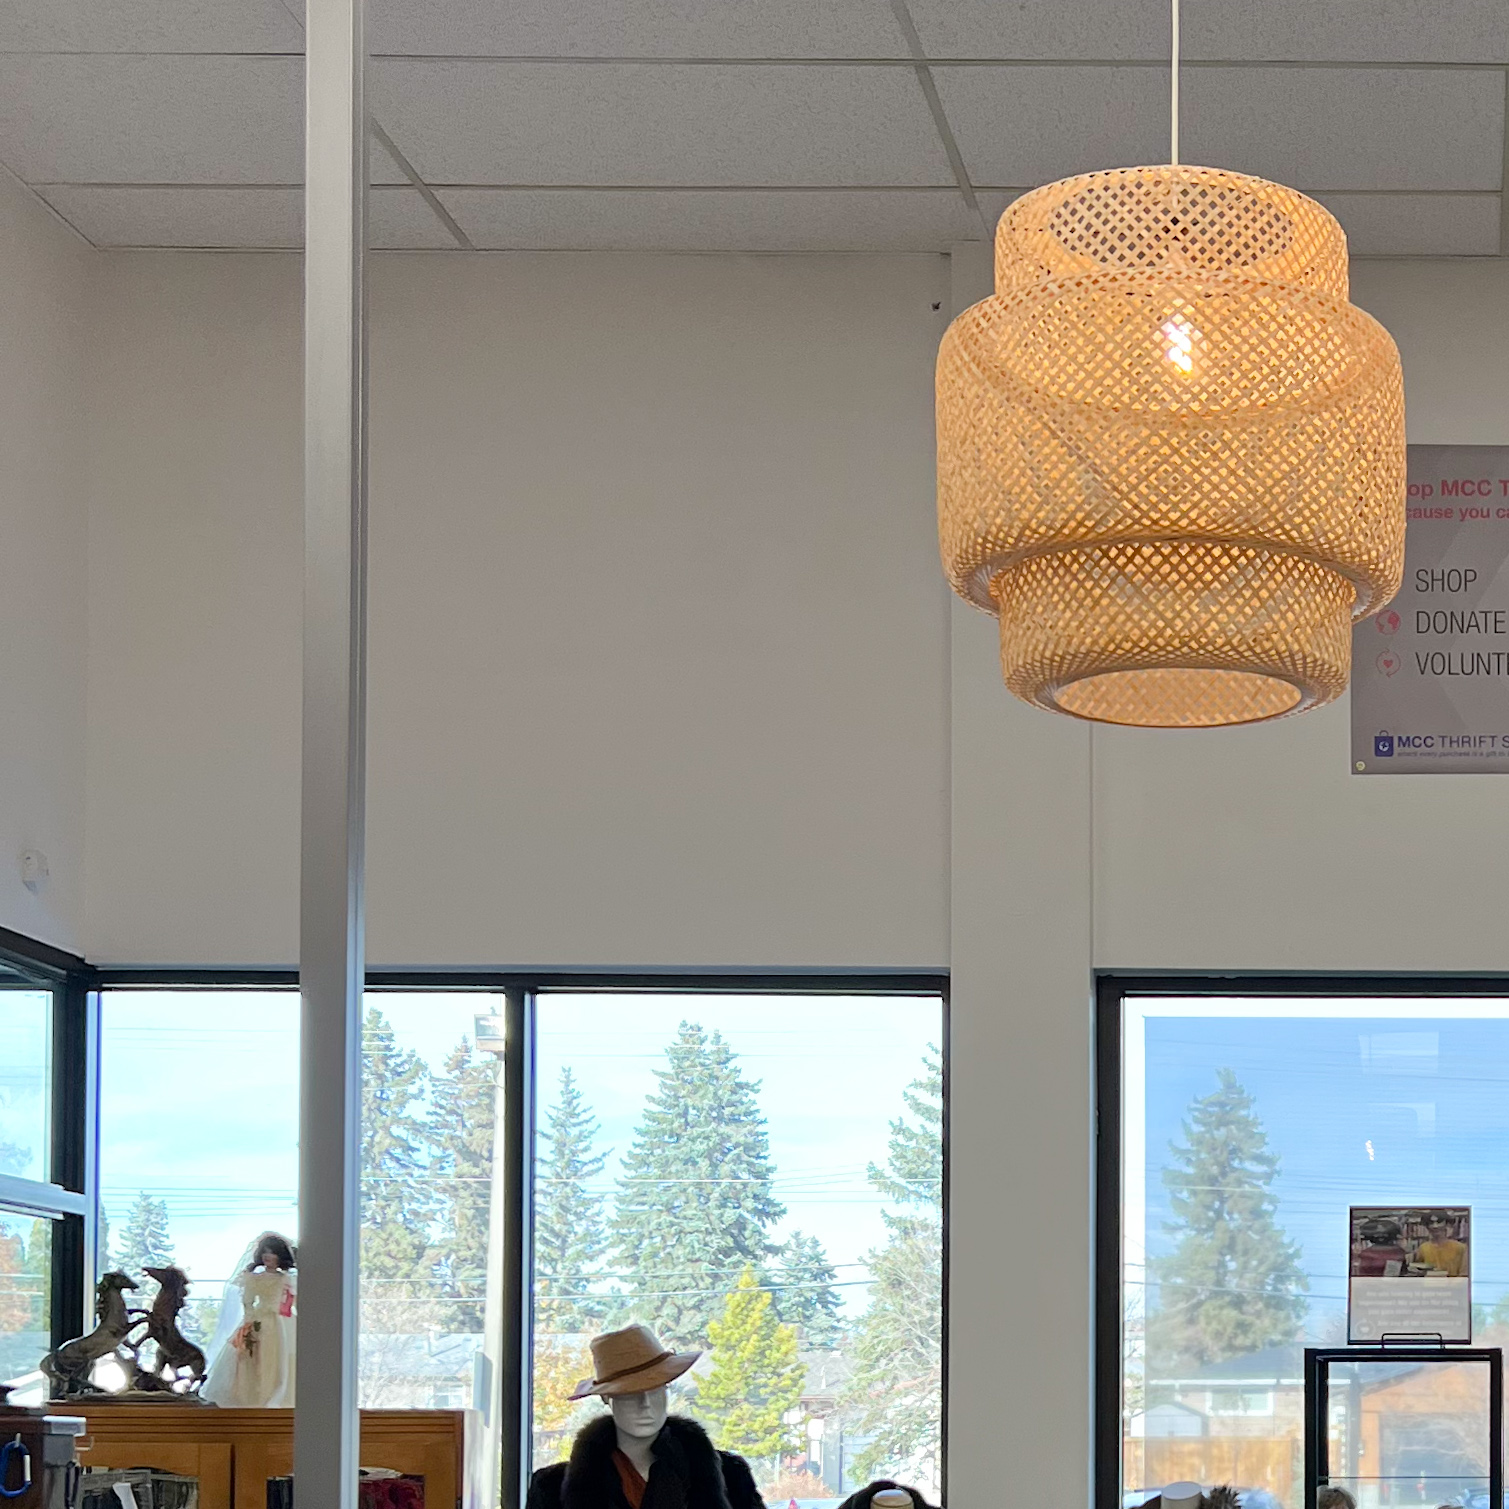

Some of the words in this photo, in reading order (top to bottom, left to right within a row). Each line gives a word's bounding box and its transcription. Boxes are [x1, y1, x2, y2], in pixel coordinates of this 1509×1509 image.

[1406, 483, 1434, 500] op
[1440, 479, 1493, 497] MCC
[1405, 506, 1454, 520] cause
[1459, 507, 1490, 522] you
[1415, 568, 1478, 593] SHOP
[1416, 610, 1507, 634] DONATE
[1397, 735, 1435, 748] MCC
[1438, 735, 1498, 748] THRIFT
